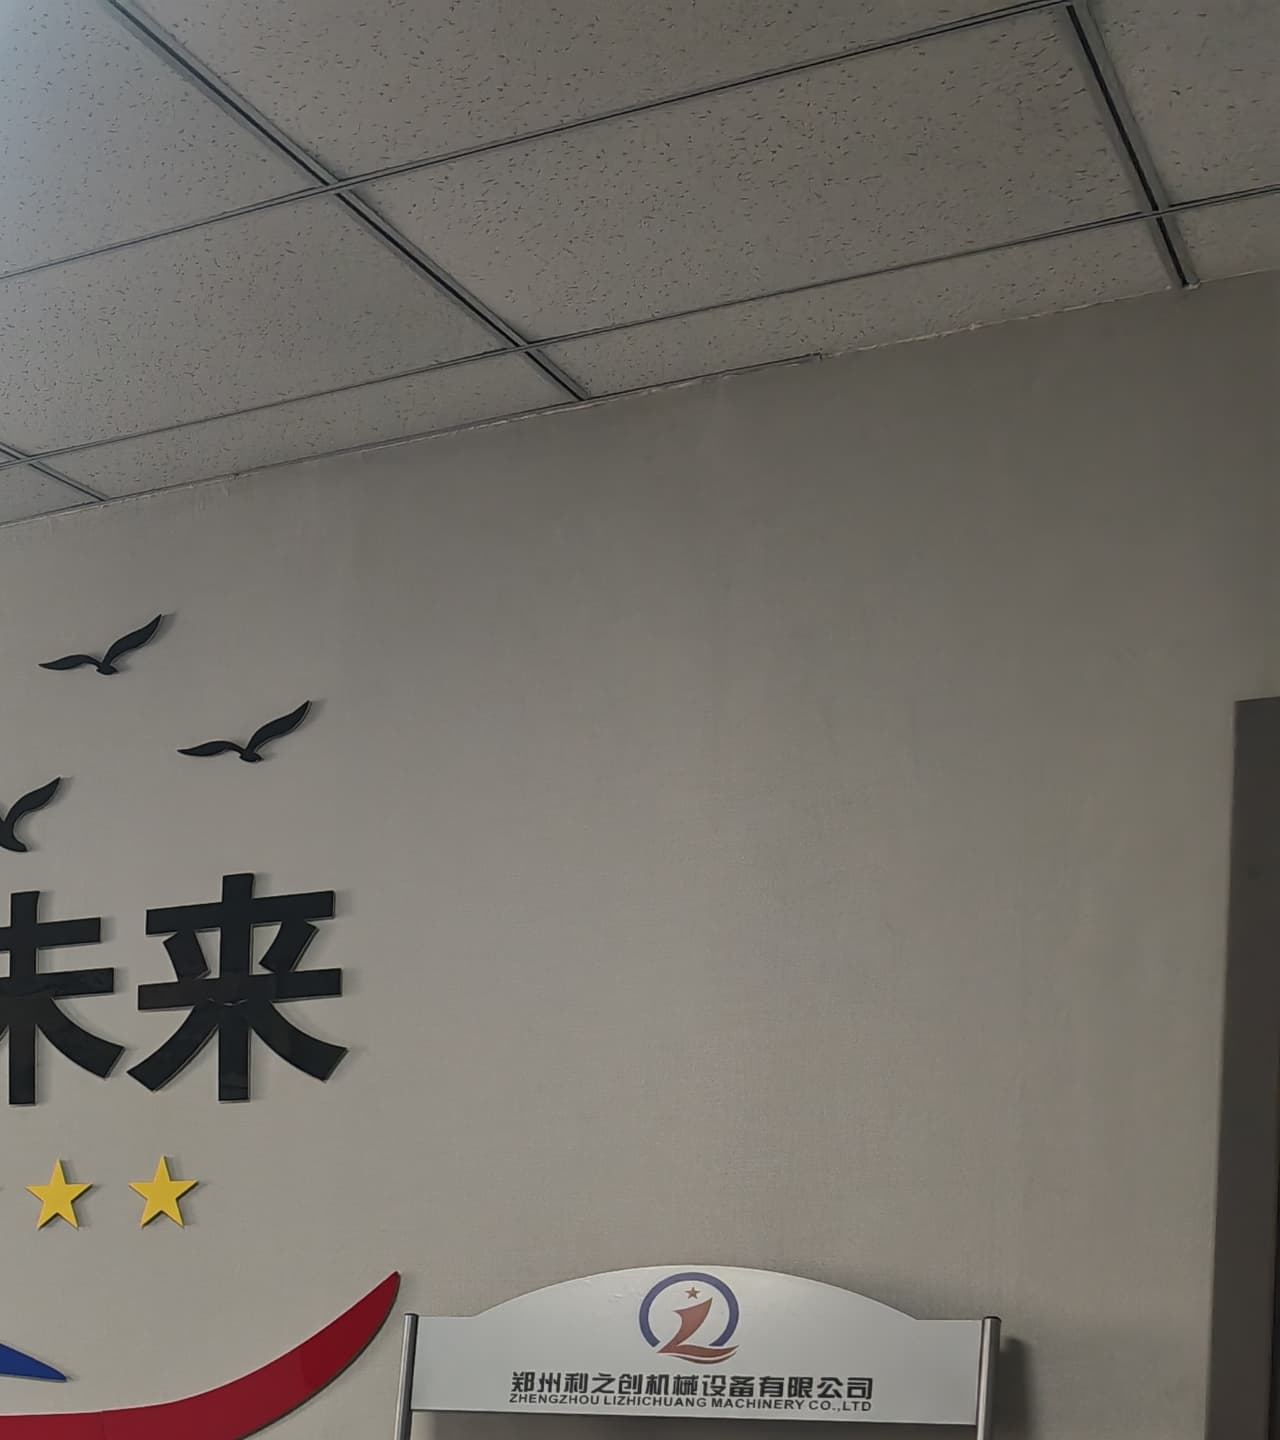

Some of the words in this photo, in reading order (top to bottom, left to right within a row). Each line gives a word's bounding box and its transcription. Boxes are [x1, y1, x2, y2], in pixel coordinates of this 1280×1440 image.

[510, 1371, 873, 1400] 郑州利之创机械设备有限公司
[509, 1393, 600, 1406] ZHENGZHOU
[603, 1395, 707, 1408] LIZHICHUANG
[711, 1397, 804, 1410] MACHINERY
